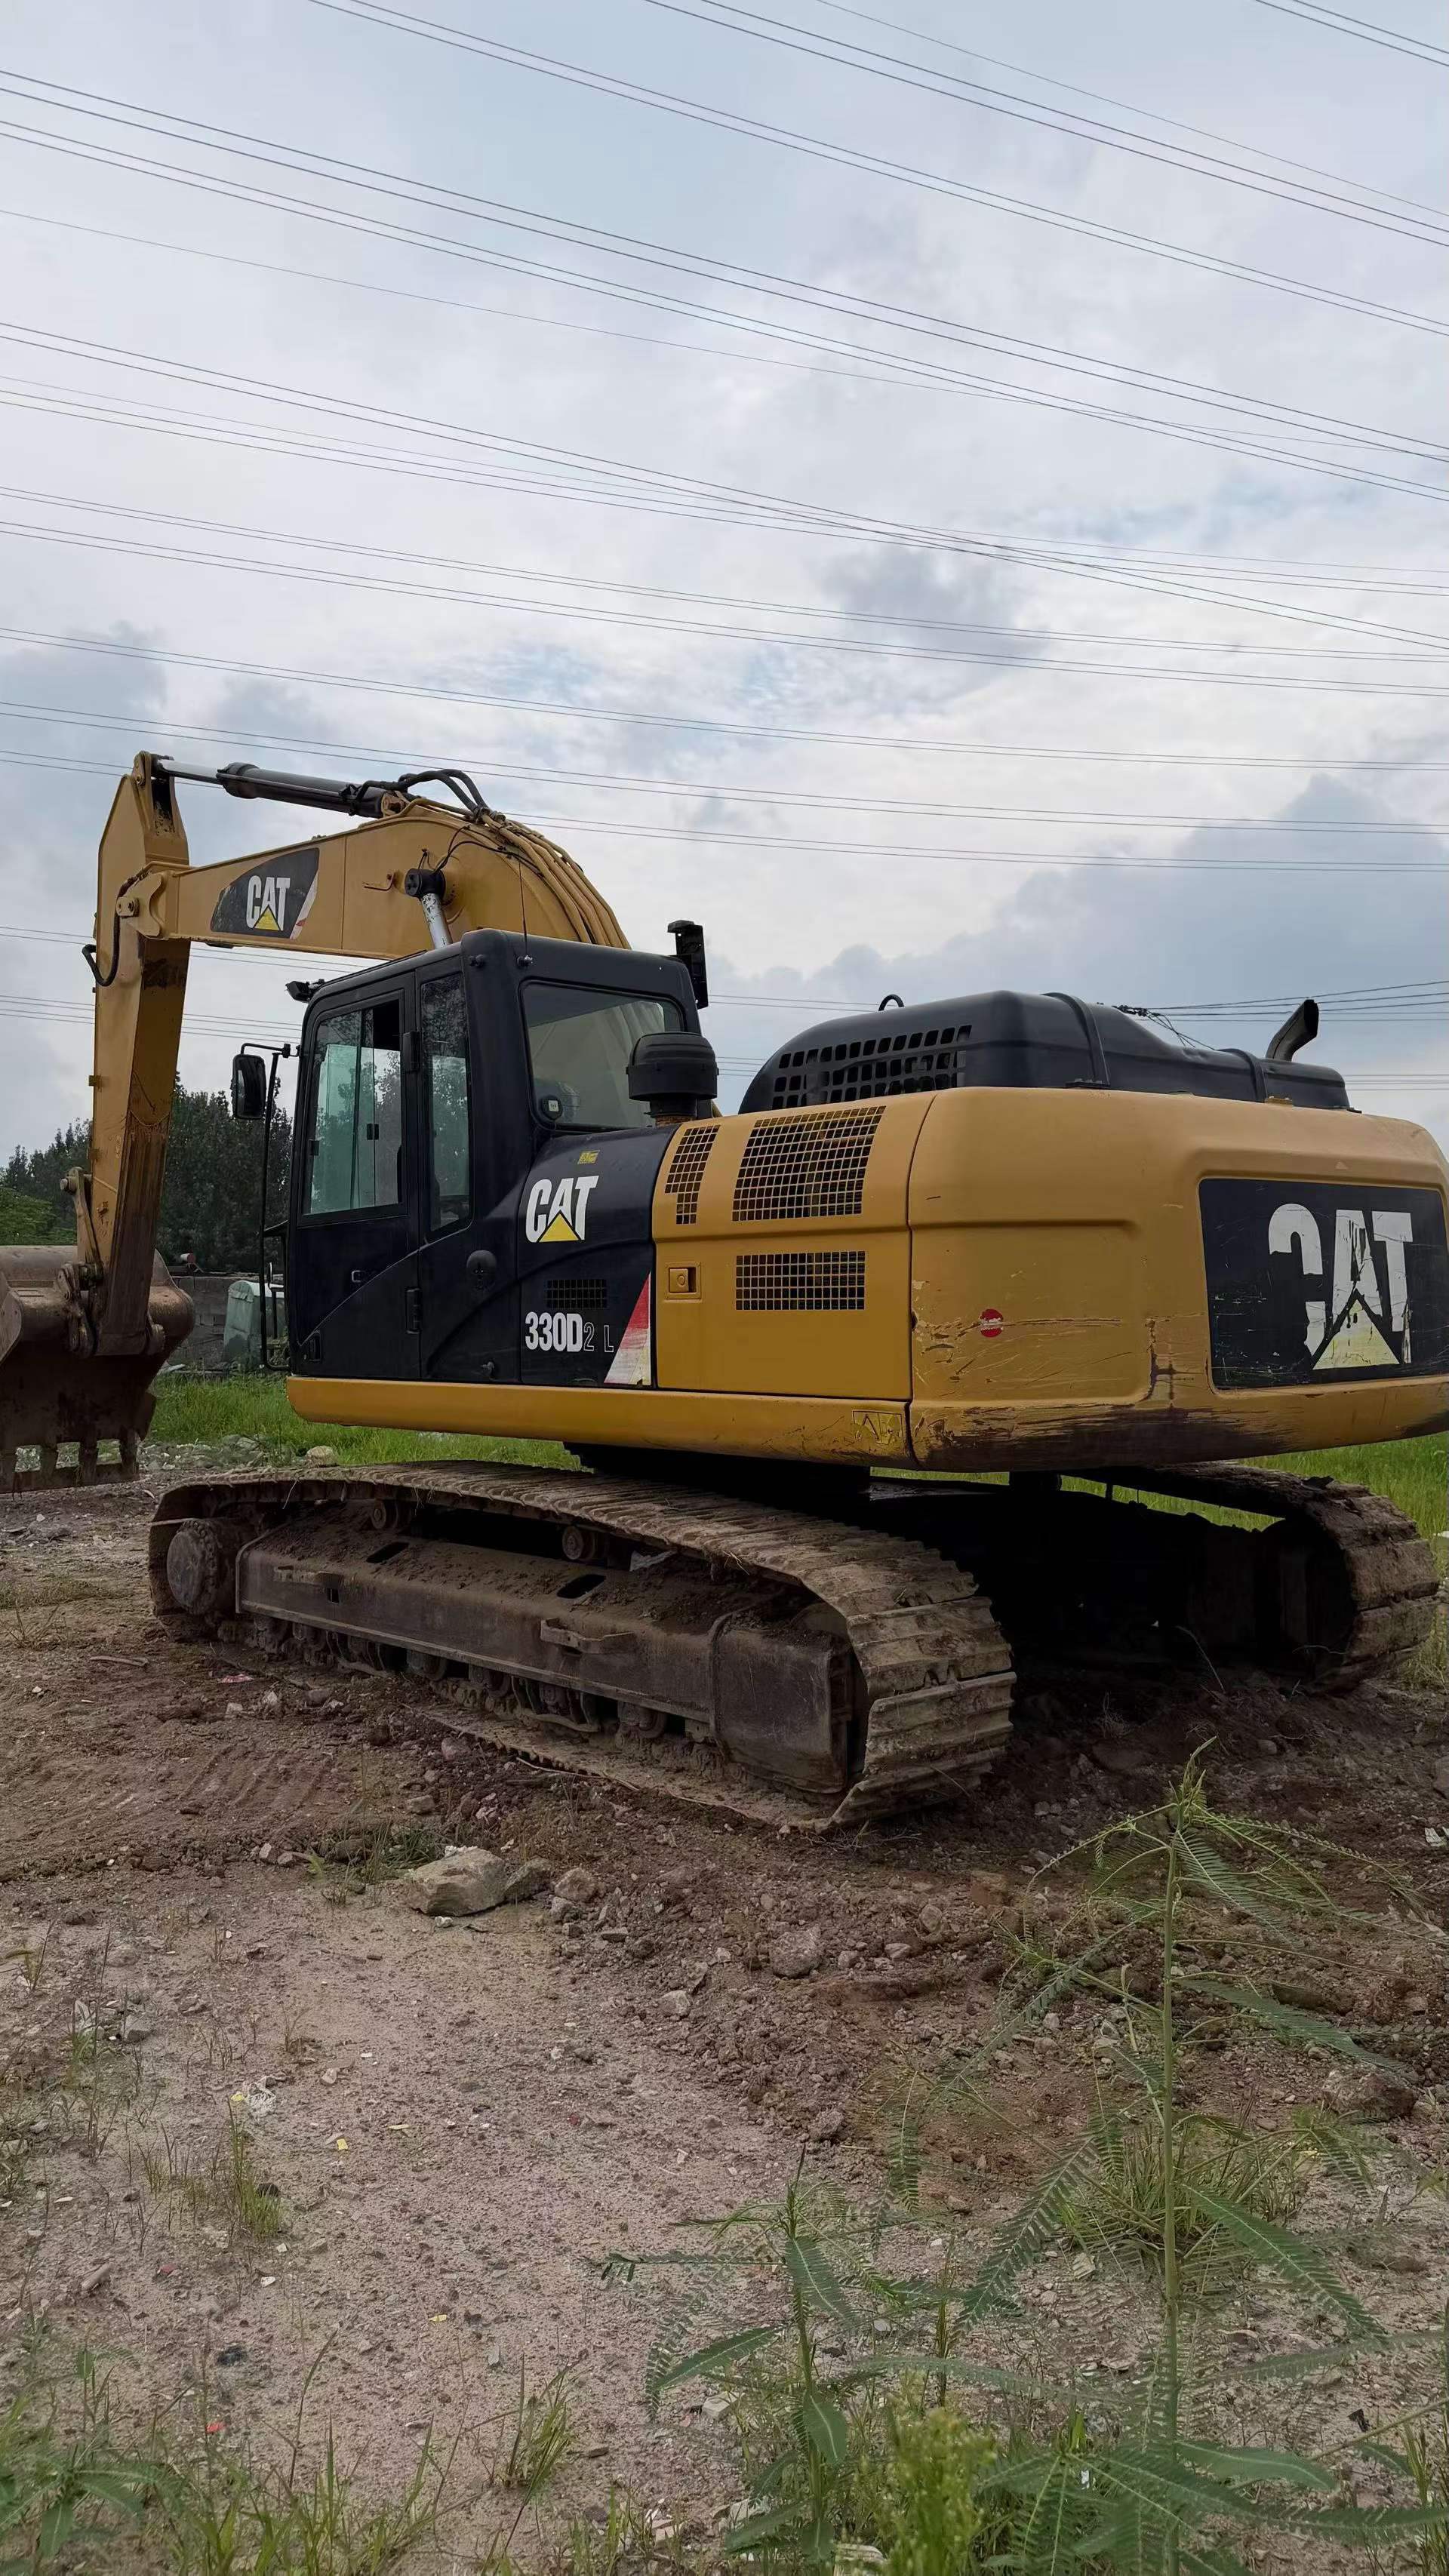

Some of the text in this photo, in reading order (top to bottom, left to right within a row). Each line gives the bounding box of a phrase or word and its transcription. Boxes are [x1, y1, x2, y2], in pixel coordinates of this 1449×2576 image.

[246, 875, 291, 930] CAT
[525, 1175, 599, 1243] CAT
[605, 1325, 614, 1353] L
